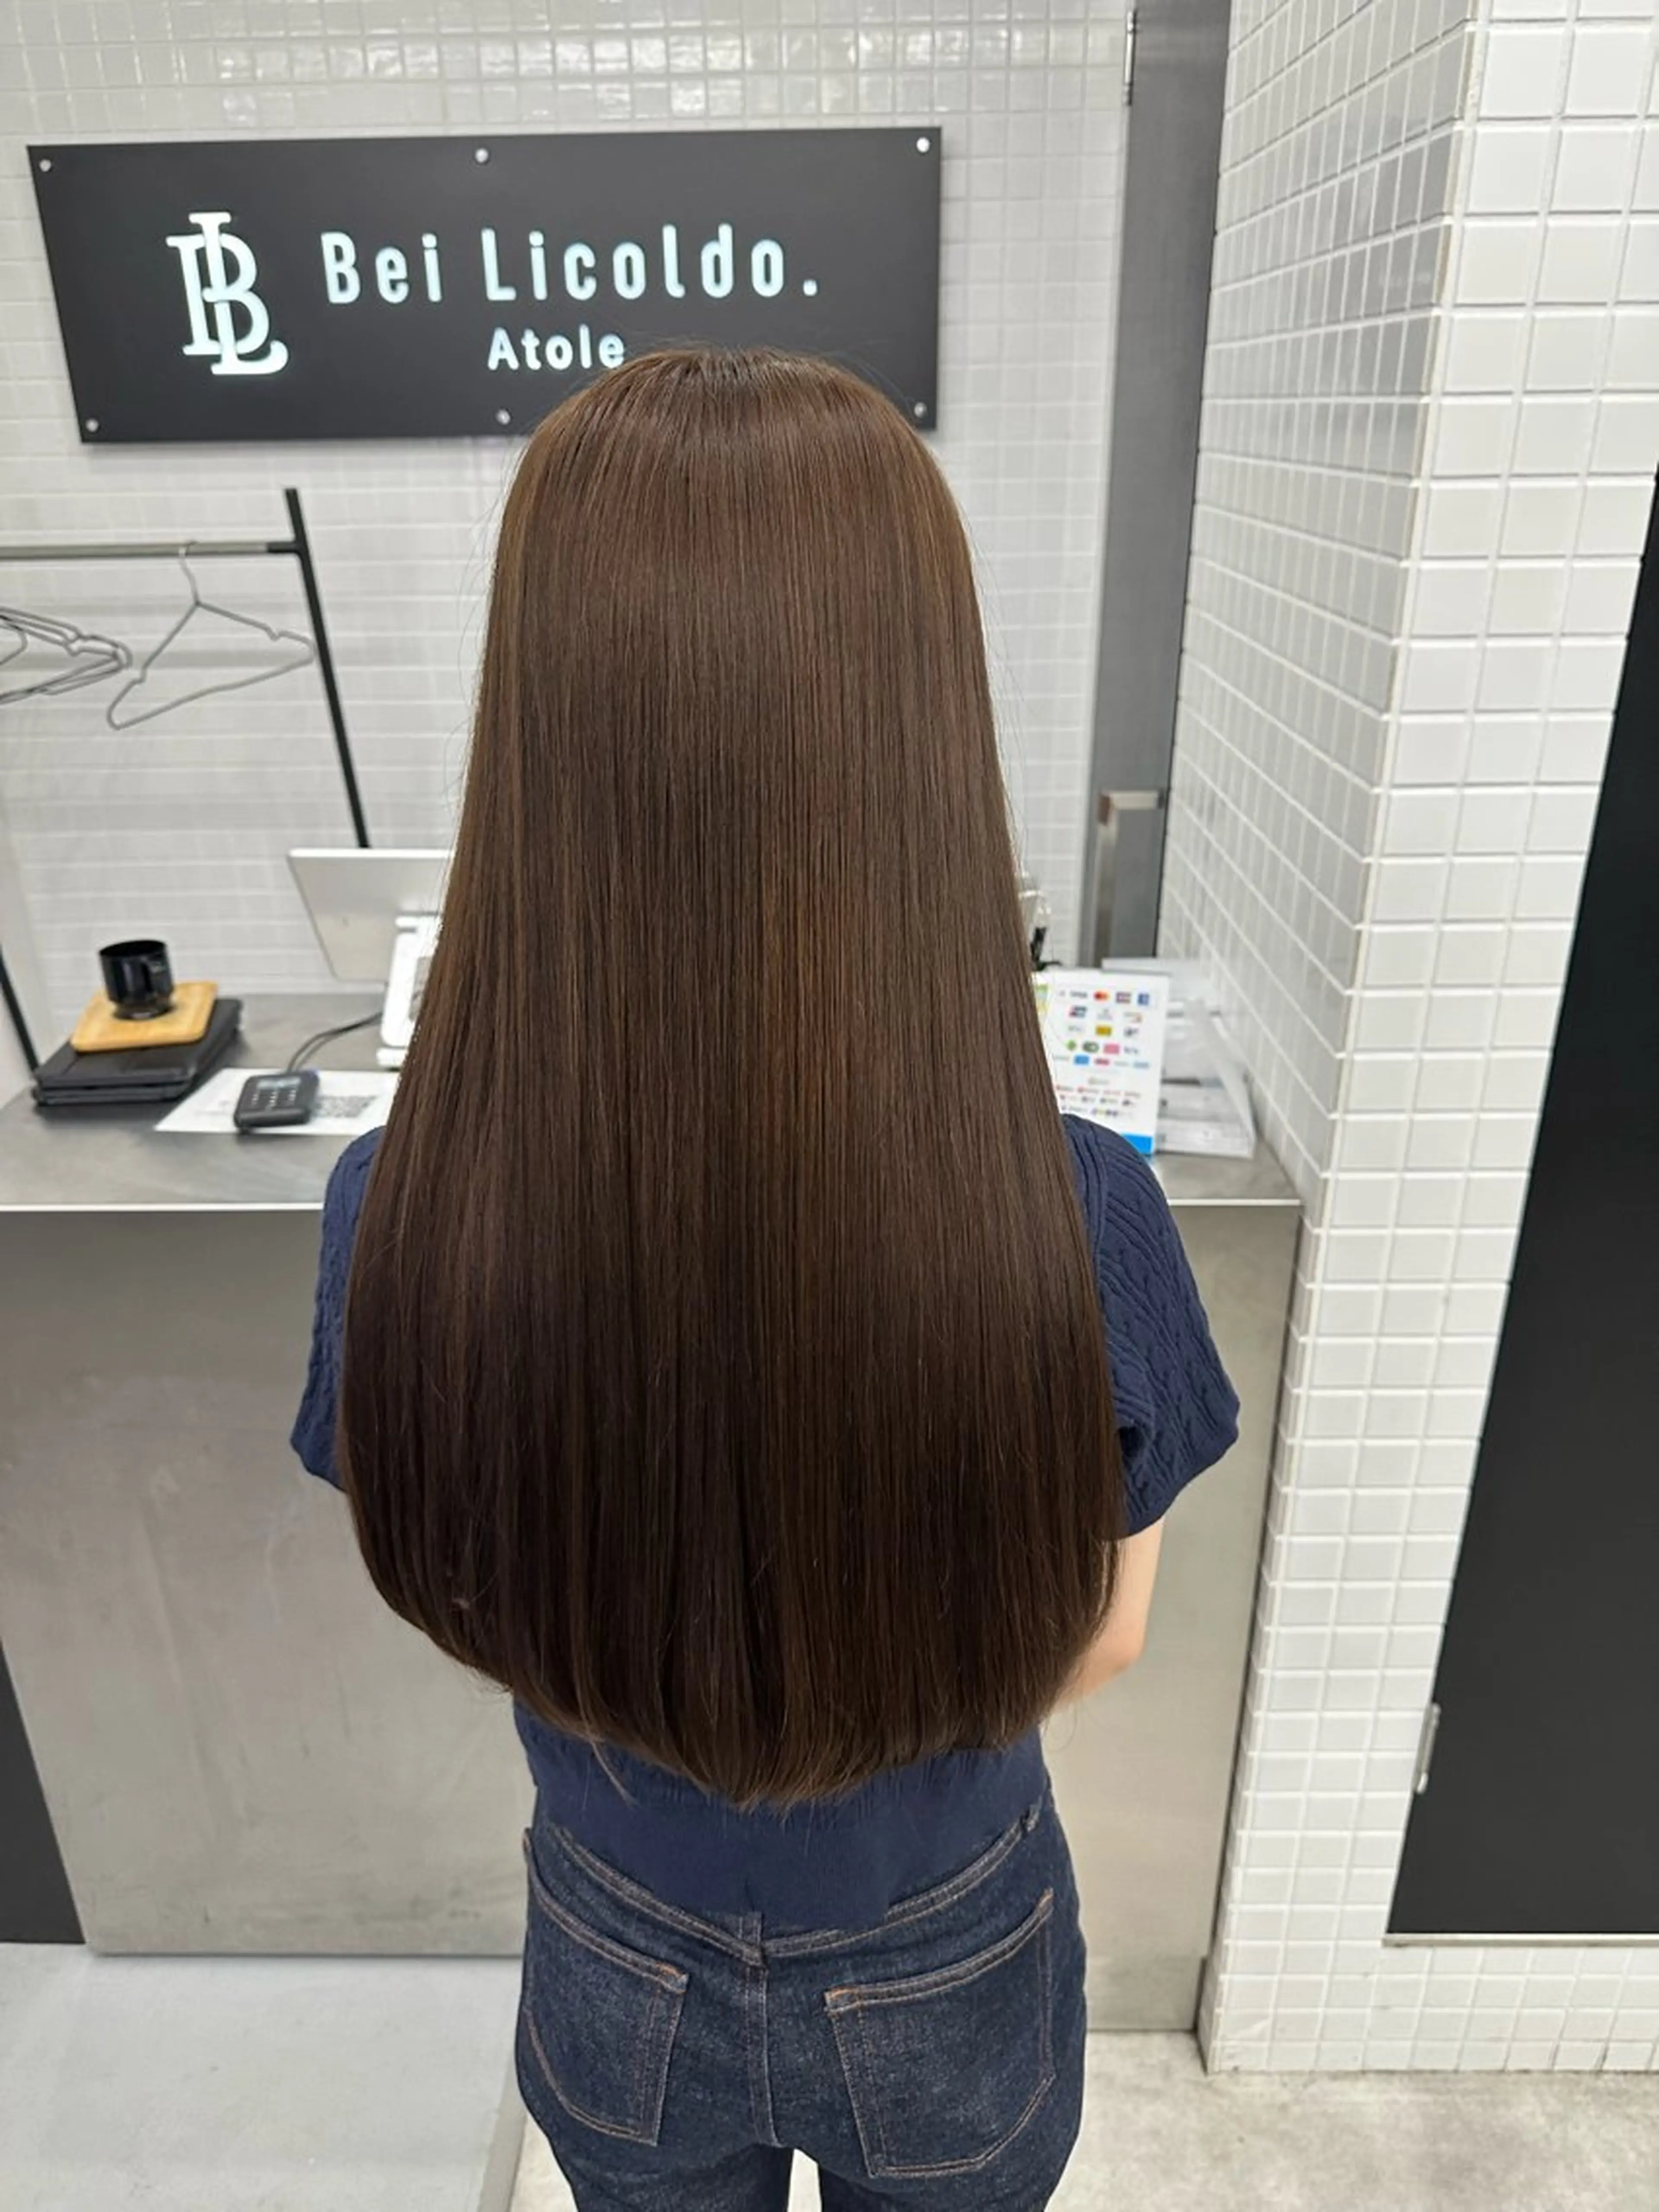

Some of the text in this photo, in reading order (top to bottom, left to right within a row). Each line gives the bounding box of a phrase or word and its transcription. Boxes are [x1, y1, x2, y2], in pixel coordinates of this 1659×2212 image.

[321, 223, 817, 304] Bei Licoldo.
[487, 324, 625, 370] Atole
